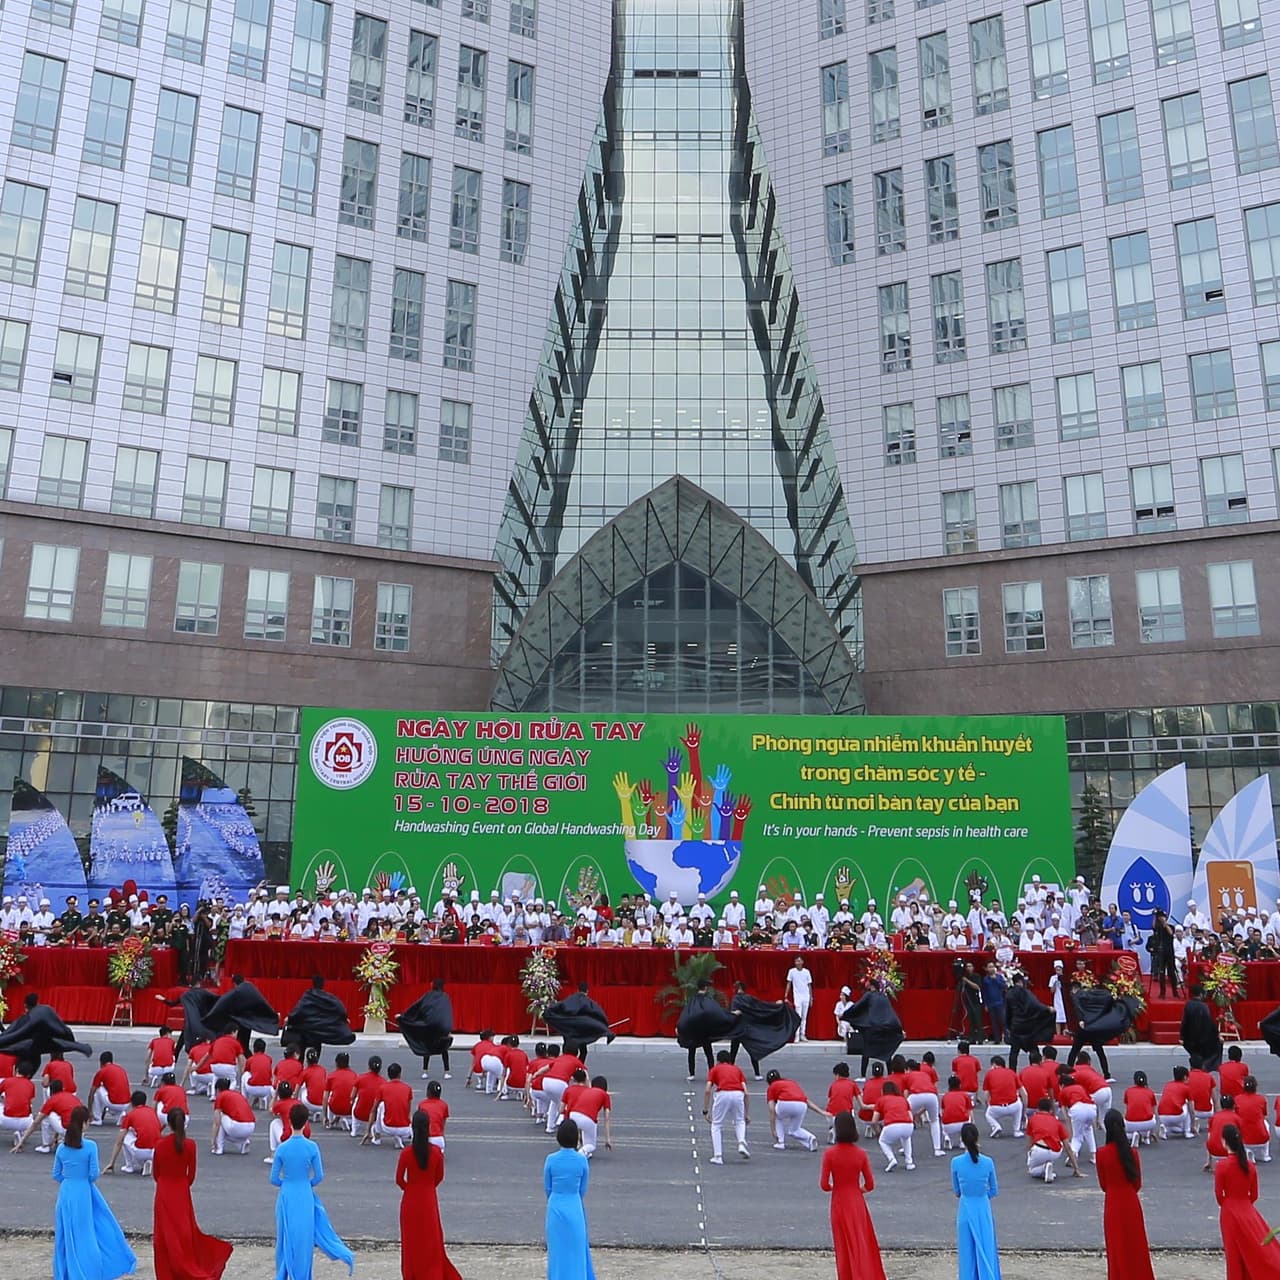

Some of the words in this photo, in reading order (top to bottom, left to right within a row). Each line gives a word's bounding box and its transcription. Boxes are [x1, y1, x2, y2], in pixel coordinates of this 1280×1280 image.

[396, 716, 470, 739] NGÀY
[475, 718, 521, 743] HỘI
[528, 716, 584, 740] RỬA
[591, 721, 645, 740] TAY
[751, 734, 813, 756] Phòng
[815, 736, 861, 756] ngừa
[863, 733, 919, 753] nhiễm
[921, 732, 978, 753] khuẩn
[981, 733, 1033, 756] huyết
[336, 754, 351, 763] 108
[478, 745, 523, 766] ỨNG
[528, 746, 591, 767] NGÀY
[394, 768, 440, 789] RỬA
[446, 773, 491, 790] TAY
[496, 769, 538, 791] THẾ
[543, 772, 587, 791] GIỚI
[800, 765, 851, 785] trong
[854, 764, 903, 781] chăm
[907, 765, 939, 781] sóc
[943, 768, 955, 785] y
[958, 762, 976, 781] tế
[769, 793, 821, 810] Chính
[825, 794, 844, 810] từ
[846, 794, 875, 811] nơi
[878, 794, 913, 811] bàn
[916, 796, 945, 815] tay
[948, 793, 981, 811] của
[984, 794, 1019, 814] bạn
[394, 820, 470, 836] Handwashing
[472, 821, 506, 834] Event
[507, 824, 522, 835] on
[524, 822, 559, 835] Global
[560, 822, 636, 837] Handwashing
[638, 823, 661, 837] Day
[762, 823, 780, 836] It's
[782, 824, 793, 836] in
[794, 827, 822, 839] your
[823, 824, 858, 837] hands
[867, 825, 913, 838] Prevent
[915, 825, 950, 840] sepsis
[952, 825, 963, 838] in
[965, 825, 1001, 838] health
[1003, 828, 1029, 838] care
